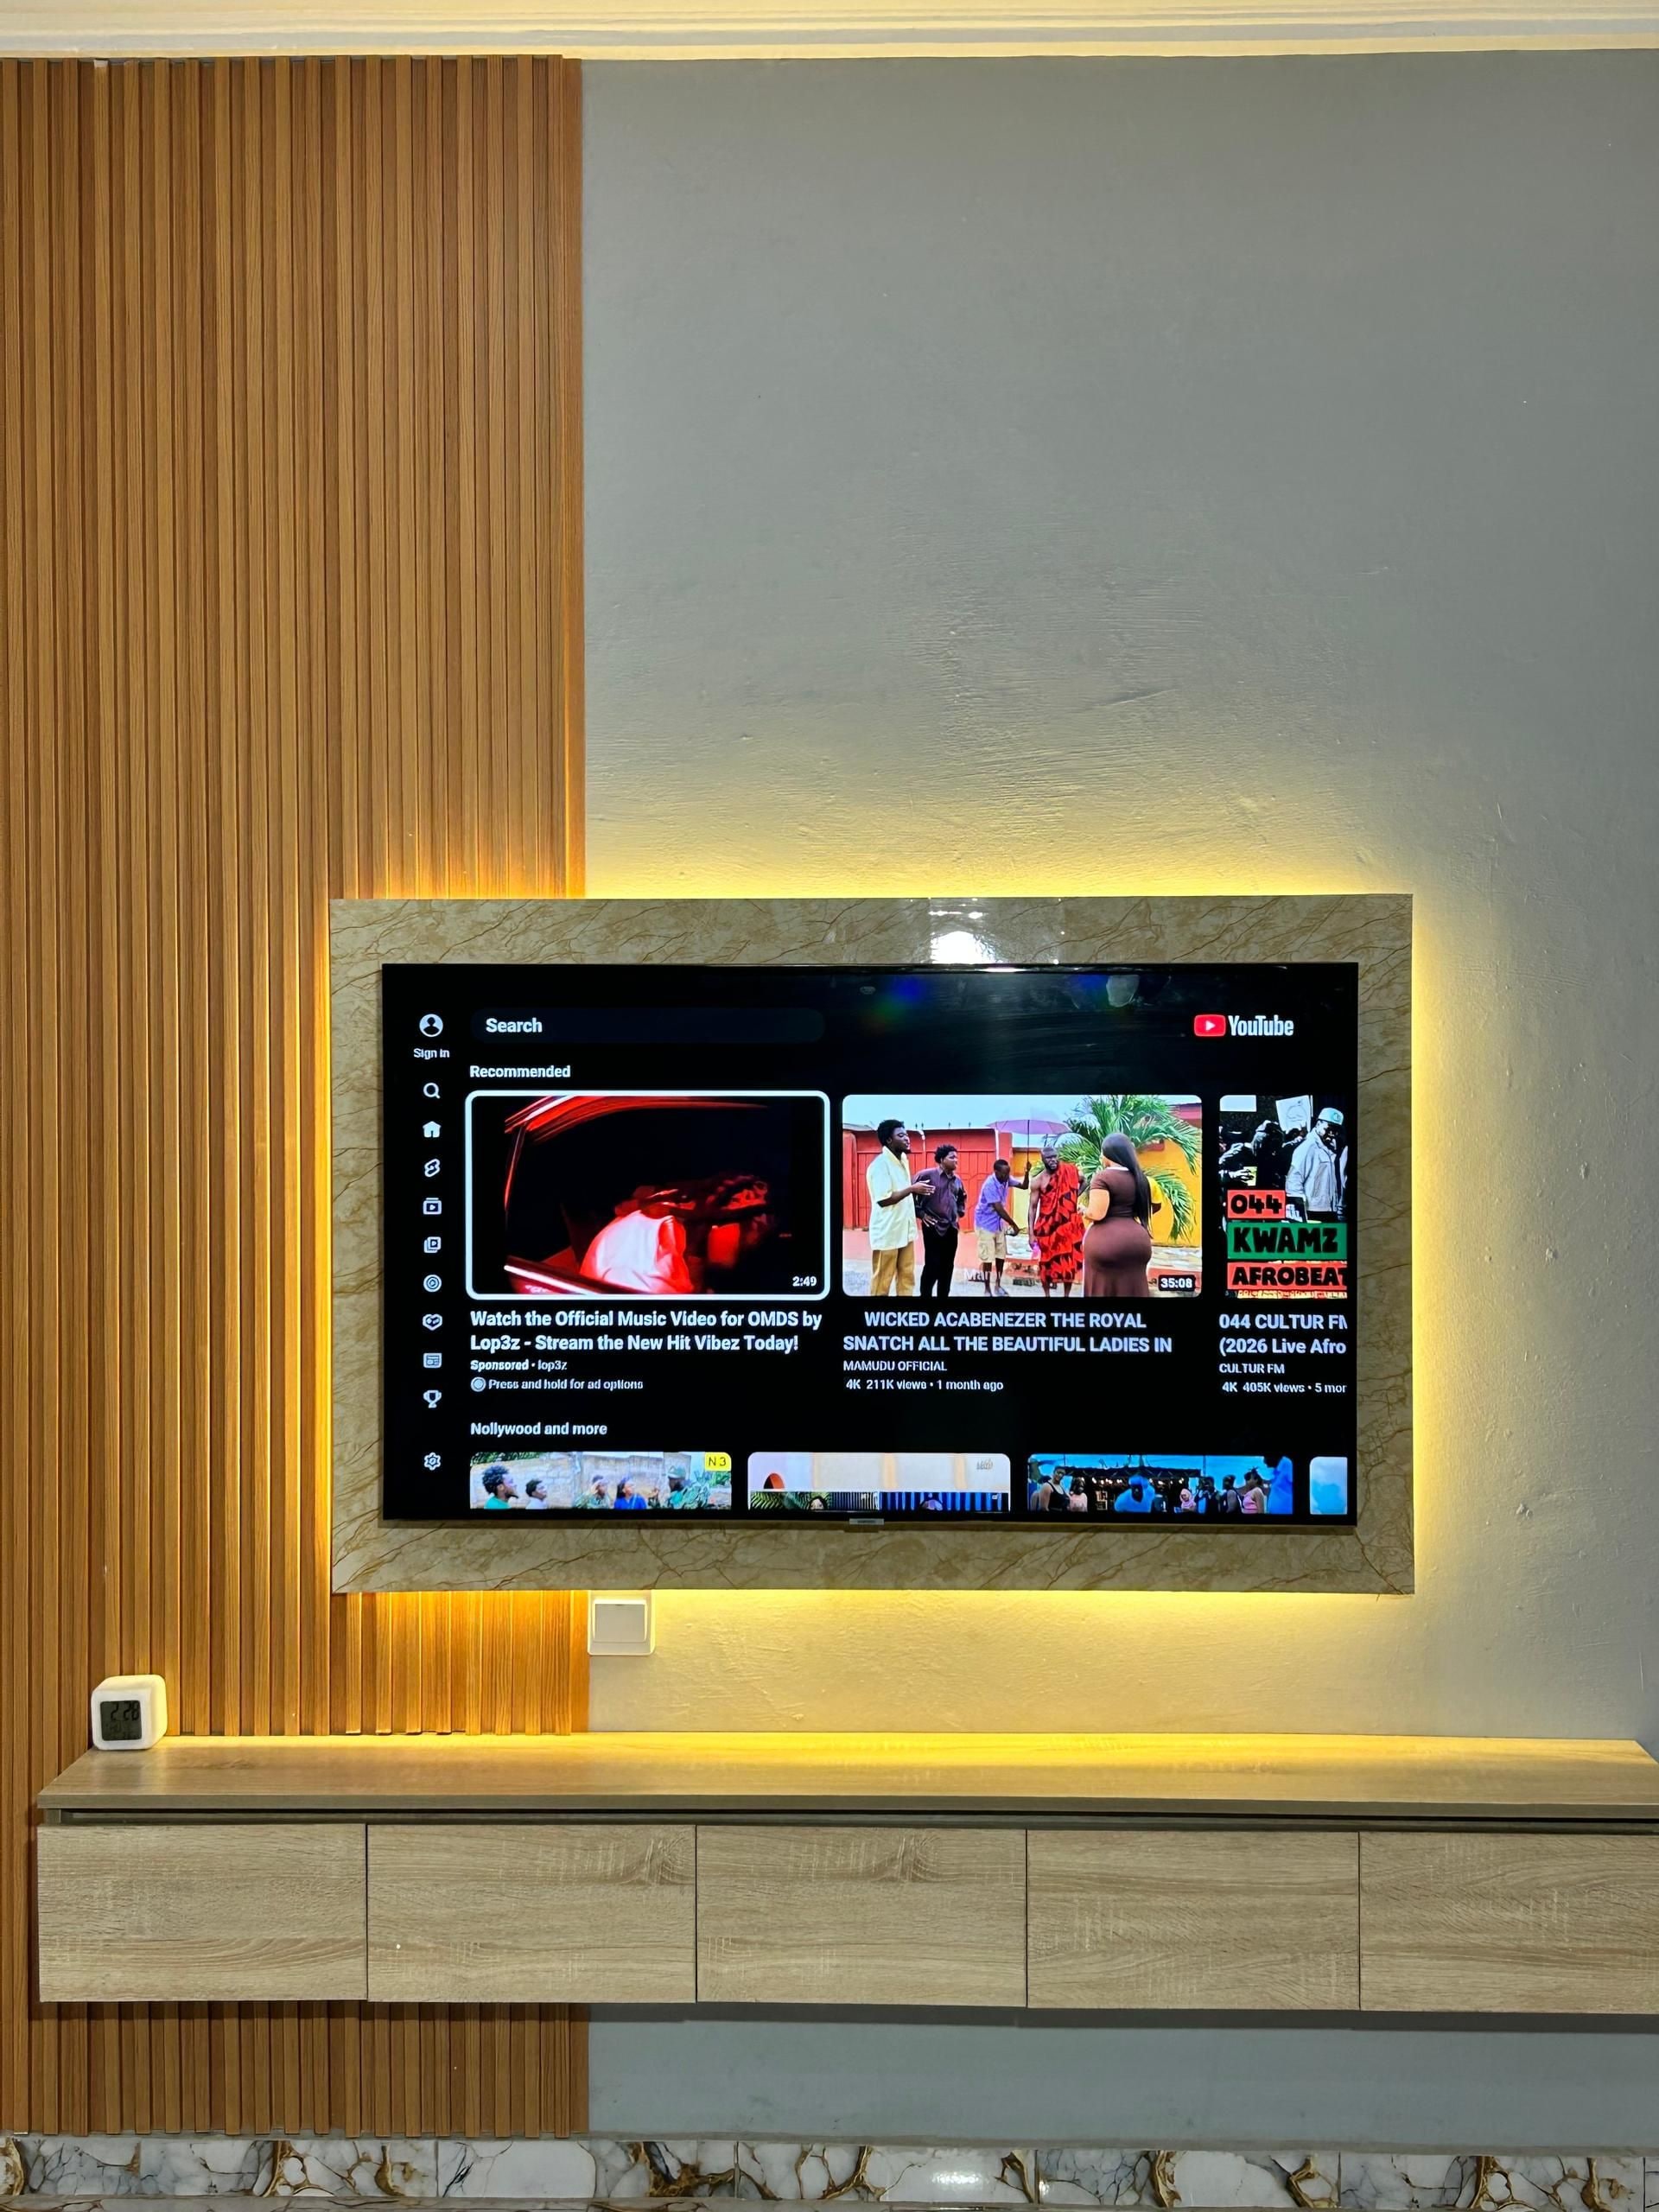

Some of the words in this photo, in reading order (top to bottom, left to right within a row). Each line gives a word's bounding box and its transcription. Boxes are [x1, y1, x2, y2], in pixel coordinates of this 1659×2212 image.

[486, 1017, 543, 1033] Search
[1228, 1014, 1294, 1036] YouTube
[413, 1047, 438, 1060] Sign
[439, 1048, 450, 1058] in
[469, 1065, 571, 1078] Recommended
[1230, 1194, 1282, 1215] 044
[1233, 1227, 1338, 1253] KWAMZ
[792, 1275, 817, 1287] 2:49
[1160, 1277, 1192, 1288] 35:08
[470, 1310, 521, 1325] Watch
[524, 1311, 551, 1325] the
[556, 1310, 613, 1325] Official
[618, 1311, 666, 1325] Music
[671, 1311, 716, 1325] Video
[721, 1311, 744, 1326] for
[748, 1311, 798, 1326] OMDS
[803, 1311, 822, 1331] by
[864, 1312, 930, 1327] WICKED
[934, 1312, 1046, 1327] ACABENEZER
[1051, 1313, 1085, 1328] THE
[1090, 1313, 1147, 1328] ROYAL
[1218, 1314, 1251, 1329] 044
[1255, 1314, 1325, 1329] CULTUR
[470, 1335, 520, 1354] Lop3z
[535, 1335, 593, 1351] Stream
[597, 1334, 624, 1351] the
[628, 1335, 663, 1351] New
[667, 1335, 690, 1351] Hit
[695, 1335, 741, 1351] Vibez
[743, 1335, 798, 1355] Today!
[842, 1336, 913, 1351] SNATCH
[918, 1336, 950, 1351] ALL
[954, 1336, 988, 1351] THE
[992, 1336, 1086, 1352] BEAUTIFUL
[1090, 1337, 1150, 1353] LADIES
[1154, 1338, 1173, 1353] IN
[1218, 1338, 1268, 1357] (2026
[1272, 1338, 1306, 1354] Live
[1310, 1338, 1347, 1354] Afro
[470, 1358, 530, 1372] Sponsored
[537, 1359, 568, 1372] lop3z
[842, 1360, 895, 1371] MAMUDU
[898, 1360, 948, 1371] OFFICIAL
[1218, 1363, 1265, 1374] CULTUR
[1267, 1363, 1285, 1374] FM
[488, 1378, 519, 1389] Press
[521, 1378, 543, 1389] and
[543, 1378, 568, 1389] hold
[569, 1378, 586, 1389] for
[588, 1378, 601, 1389] ad
[603, 1379, 644, 1392] options
[846, 1379, 861, 1389] 4K
[866, 1379, 894, 1390] 211K
[896, 1379, 927, 1390] views
[937, 1380, 943, 1390] 1
[946, 1379, 981, 1390] month
[983, 1381, 1004, 1393] ago
[1222, 1382, 1238, 1393] 4K
[1243, 1382, 1272, 1393] 405K
[1273, 1382, 1306, 1393] views
[1314, 1382, 1323, 1393] 5
[470, 1421, 542, 1438] Nollywood
[543, 1421, 569, 1435] and
[572, 1424, 608, 1435] more
[709, 1457, 716, 1466] N
[719, 1457, 727, 1466] 3
